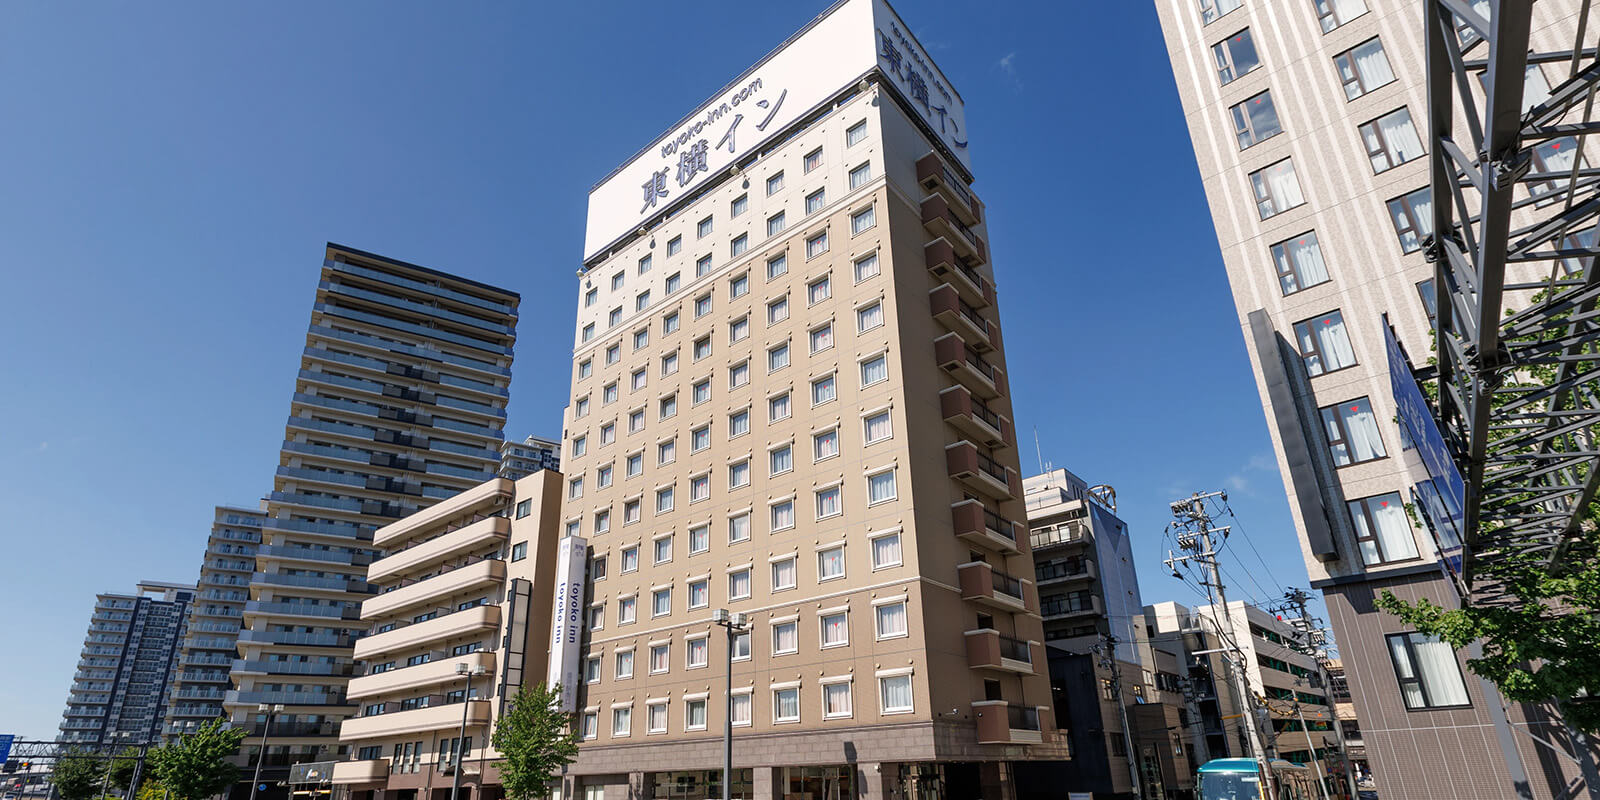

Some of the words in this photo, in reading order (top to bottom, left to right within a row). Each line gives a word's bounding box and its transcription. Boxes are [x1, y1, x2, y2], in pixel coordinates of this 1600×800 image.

[877, 28, 969, 149] 東横イン
[660, 77, 763, 159] toyoko-inn.com
[639, 88, 788, 214] 東横イン
[557, 582, 566, 622] toyoko
[570, 582, 581, 622] toyoko
[555, 624, 564, 644] inn
[568, 624, 578, 644] inn
